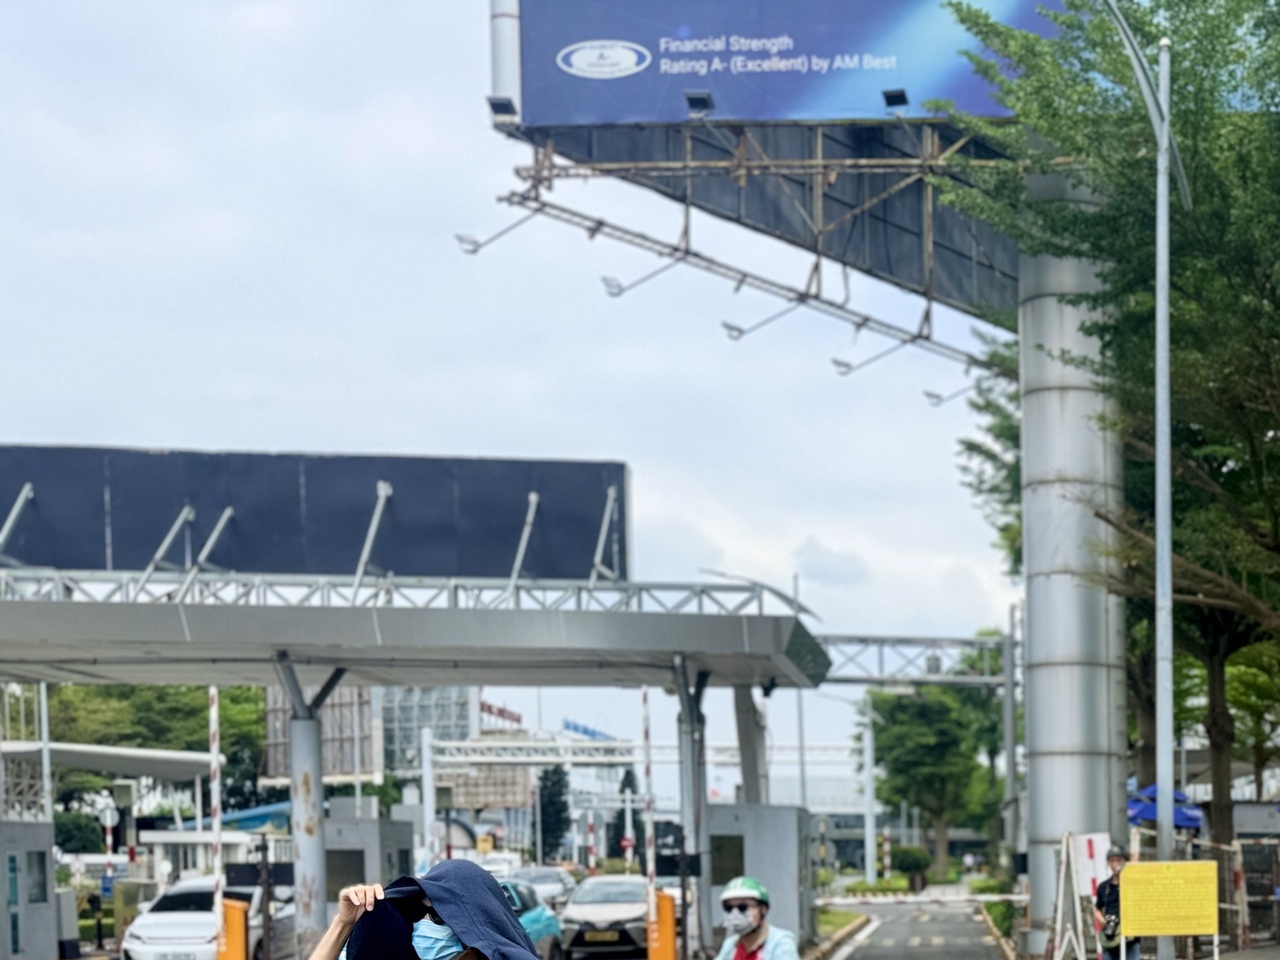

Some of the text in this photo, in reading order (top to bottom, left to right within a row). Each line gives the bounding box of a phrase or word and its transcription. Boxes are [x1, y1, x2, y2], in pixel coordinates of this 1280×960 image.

[659, 34, 794, 54] Financial Strength
[660, 54, 897, 76] Rating A- (Excellent) by AM Best
